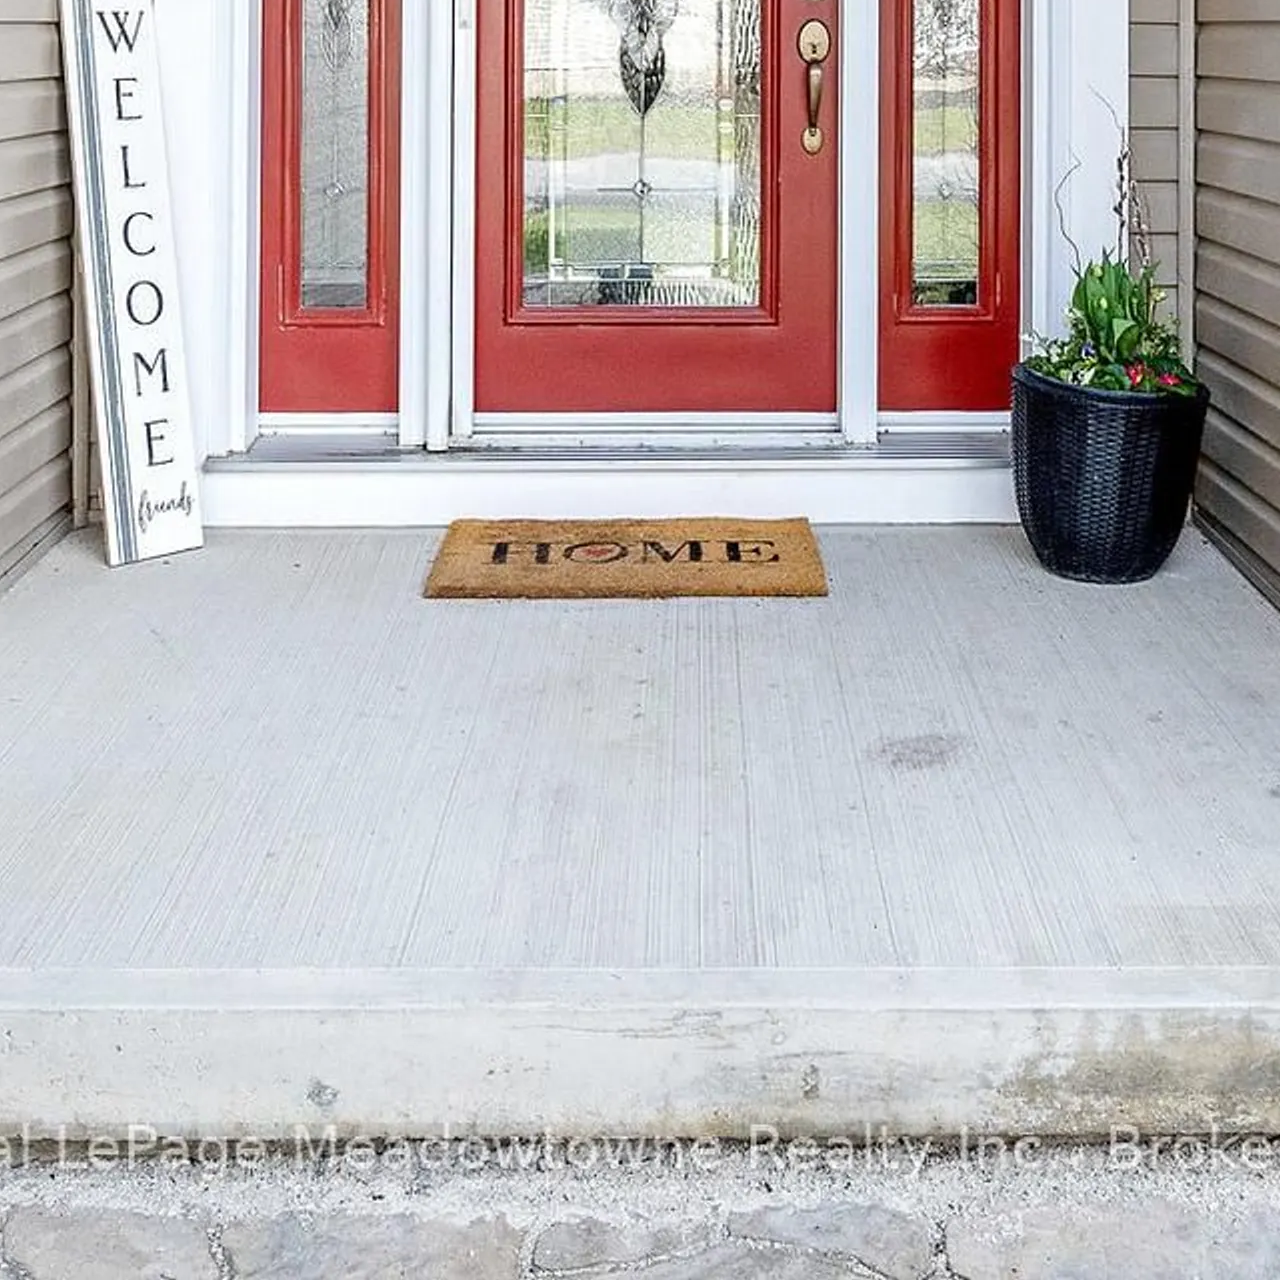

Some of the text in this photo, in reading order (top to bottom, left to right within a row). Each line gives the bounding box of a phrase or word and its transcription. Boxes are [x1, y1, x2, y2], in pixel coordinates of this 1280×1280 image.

[96, 9, 174, 467] WELCOME
[138, 481, 195, 534] friends
[484, 540, 781, 565] HOME
